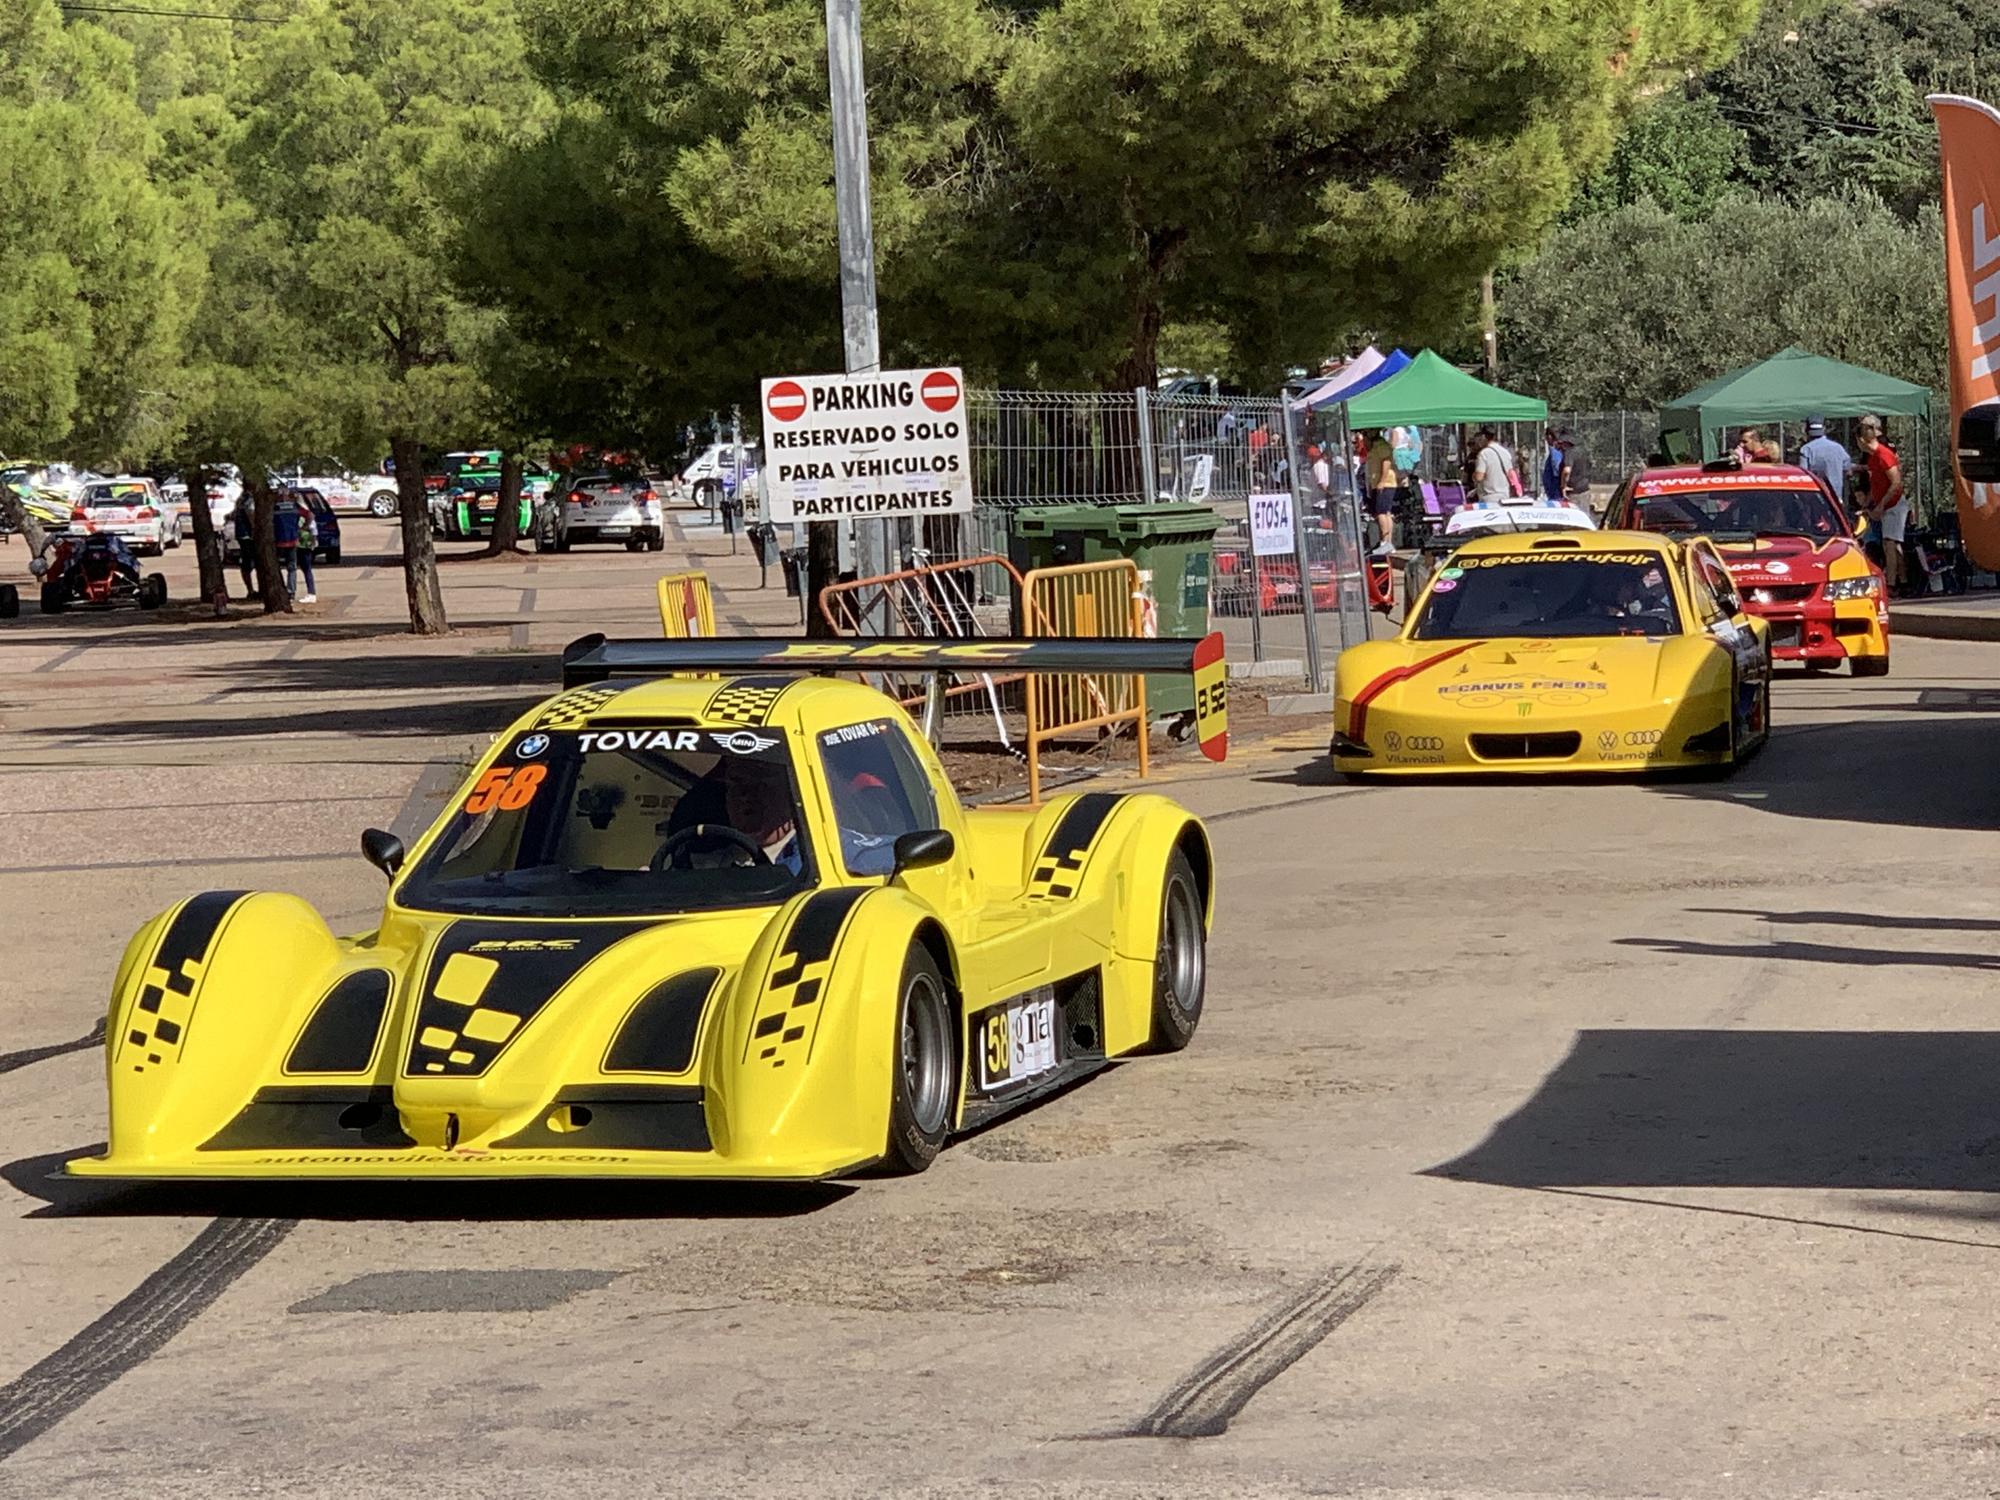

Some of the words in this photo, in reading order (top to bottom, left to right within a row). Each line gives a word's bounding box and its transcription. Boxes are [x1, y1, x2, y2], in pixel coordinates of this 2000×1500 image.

[812, 382, 914, 412] PARKING
[772, 425, 897, 449] RESERVADO
[903, 421, 960, 442] SOLO
[778, 462, 836, 482] PARA
[841, 455, 960, 478] VEHICULOS
[792, 489, 953, 517] PARTICIPANTES
[577, 731, 700, 752] TOVAR
[731, 738, 755, 747] MINI
[464, 764, 548, 815] 58
[987, 1013, 1010, 1073] 58
[254, 1153, 630, 1165] automovilestovar.com
